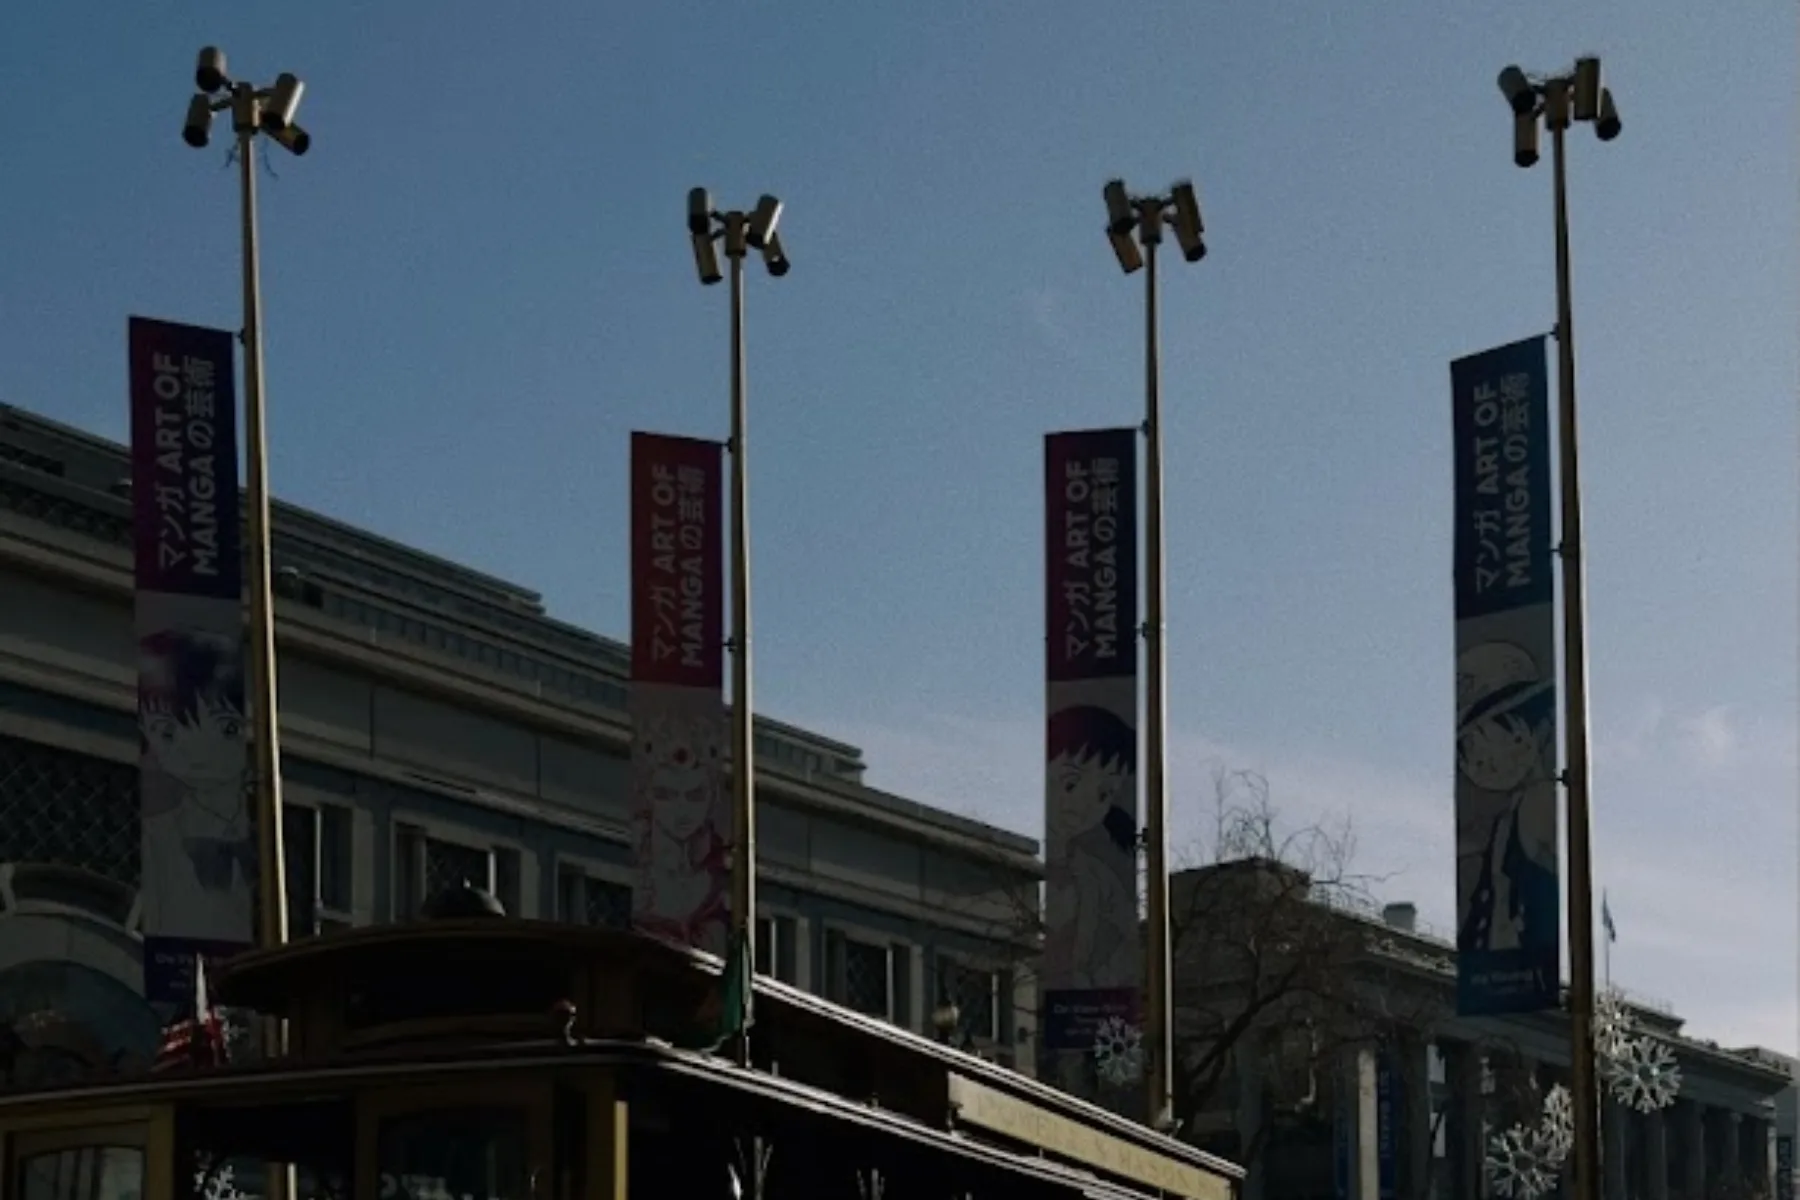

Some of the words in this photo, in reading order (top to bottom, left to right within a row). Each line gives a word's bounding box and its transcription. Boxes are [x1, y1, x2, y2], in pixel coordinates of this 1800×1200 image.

[152, 352, 182, 400] OF
[1473, 380, 1498, 427] OF
[154, 405, 184, 474] ART
[1475, 435, 1499, 495] ART
[187, 454, 220, 577] MANGA
[651, 463, 677, 507] OF
[1065, 460, 1090, 503] OF
[155, 482, 187, 571] マンガ
[651, 511, 677, 573] ART
[1065, 509, 1090, 569] ART
[1473, 510, 1501, 594] マンガ
[1504, 463, 1532, 588] MANGA
[679, 555, 705, 668] MANGA
[1061, 579, 1091, 660] マンガ
[1092, 544, 1118, 660] MANGA
